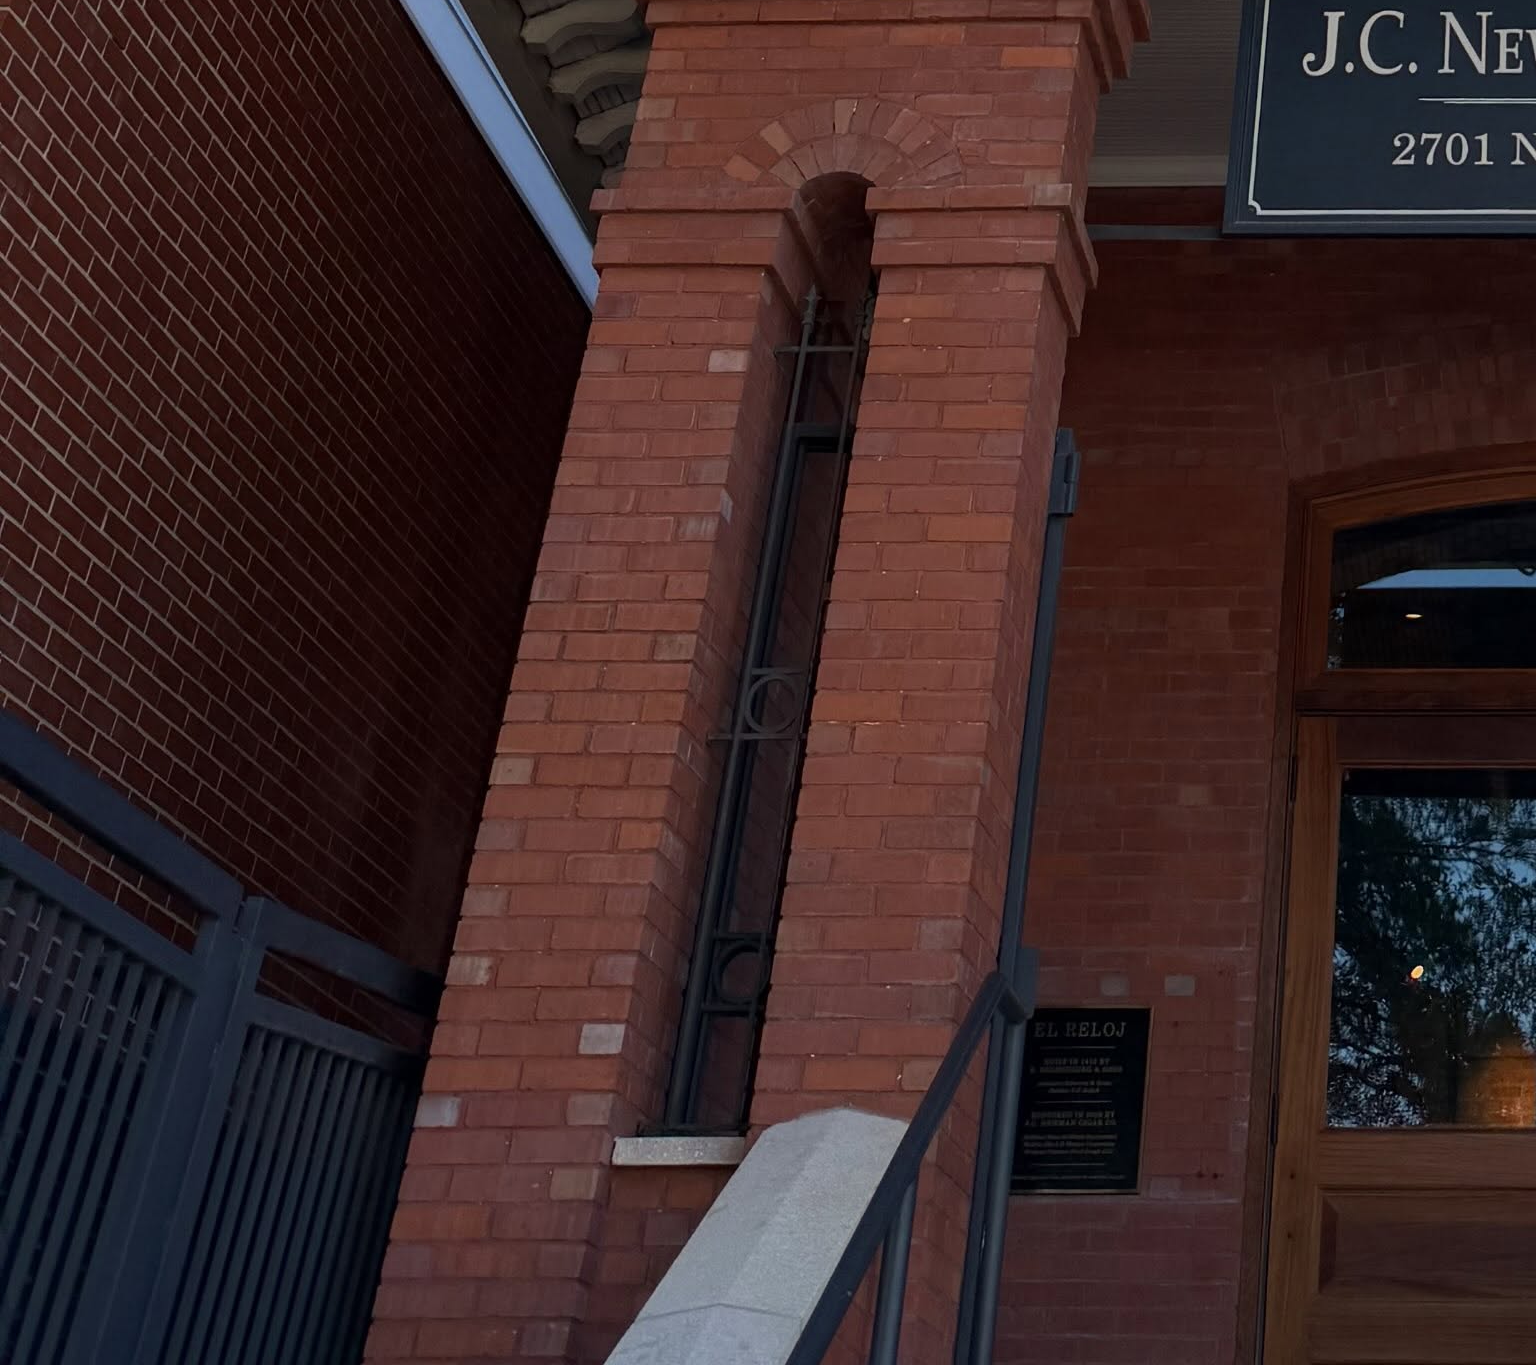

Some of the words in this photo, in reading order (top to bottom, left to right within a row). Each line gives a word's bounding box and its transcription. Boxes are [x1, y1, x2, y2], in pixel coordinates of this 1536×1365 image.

[1302, 10, 1418, 77] J.C.
[1391, 131, 1494, 167] 2701
[1033, 1021, 1058, 1038] EL
[1065, 1021, 1127, 1038] RELOJ
